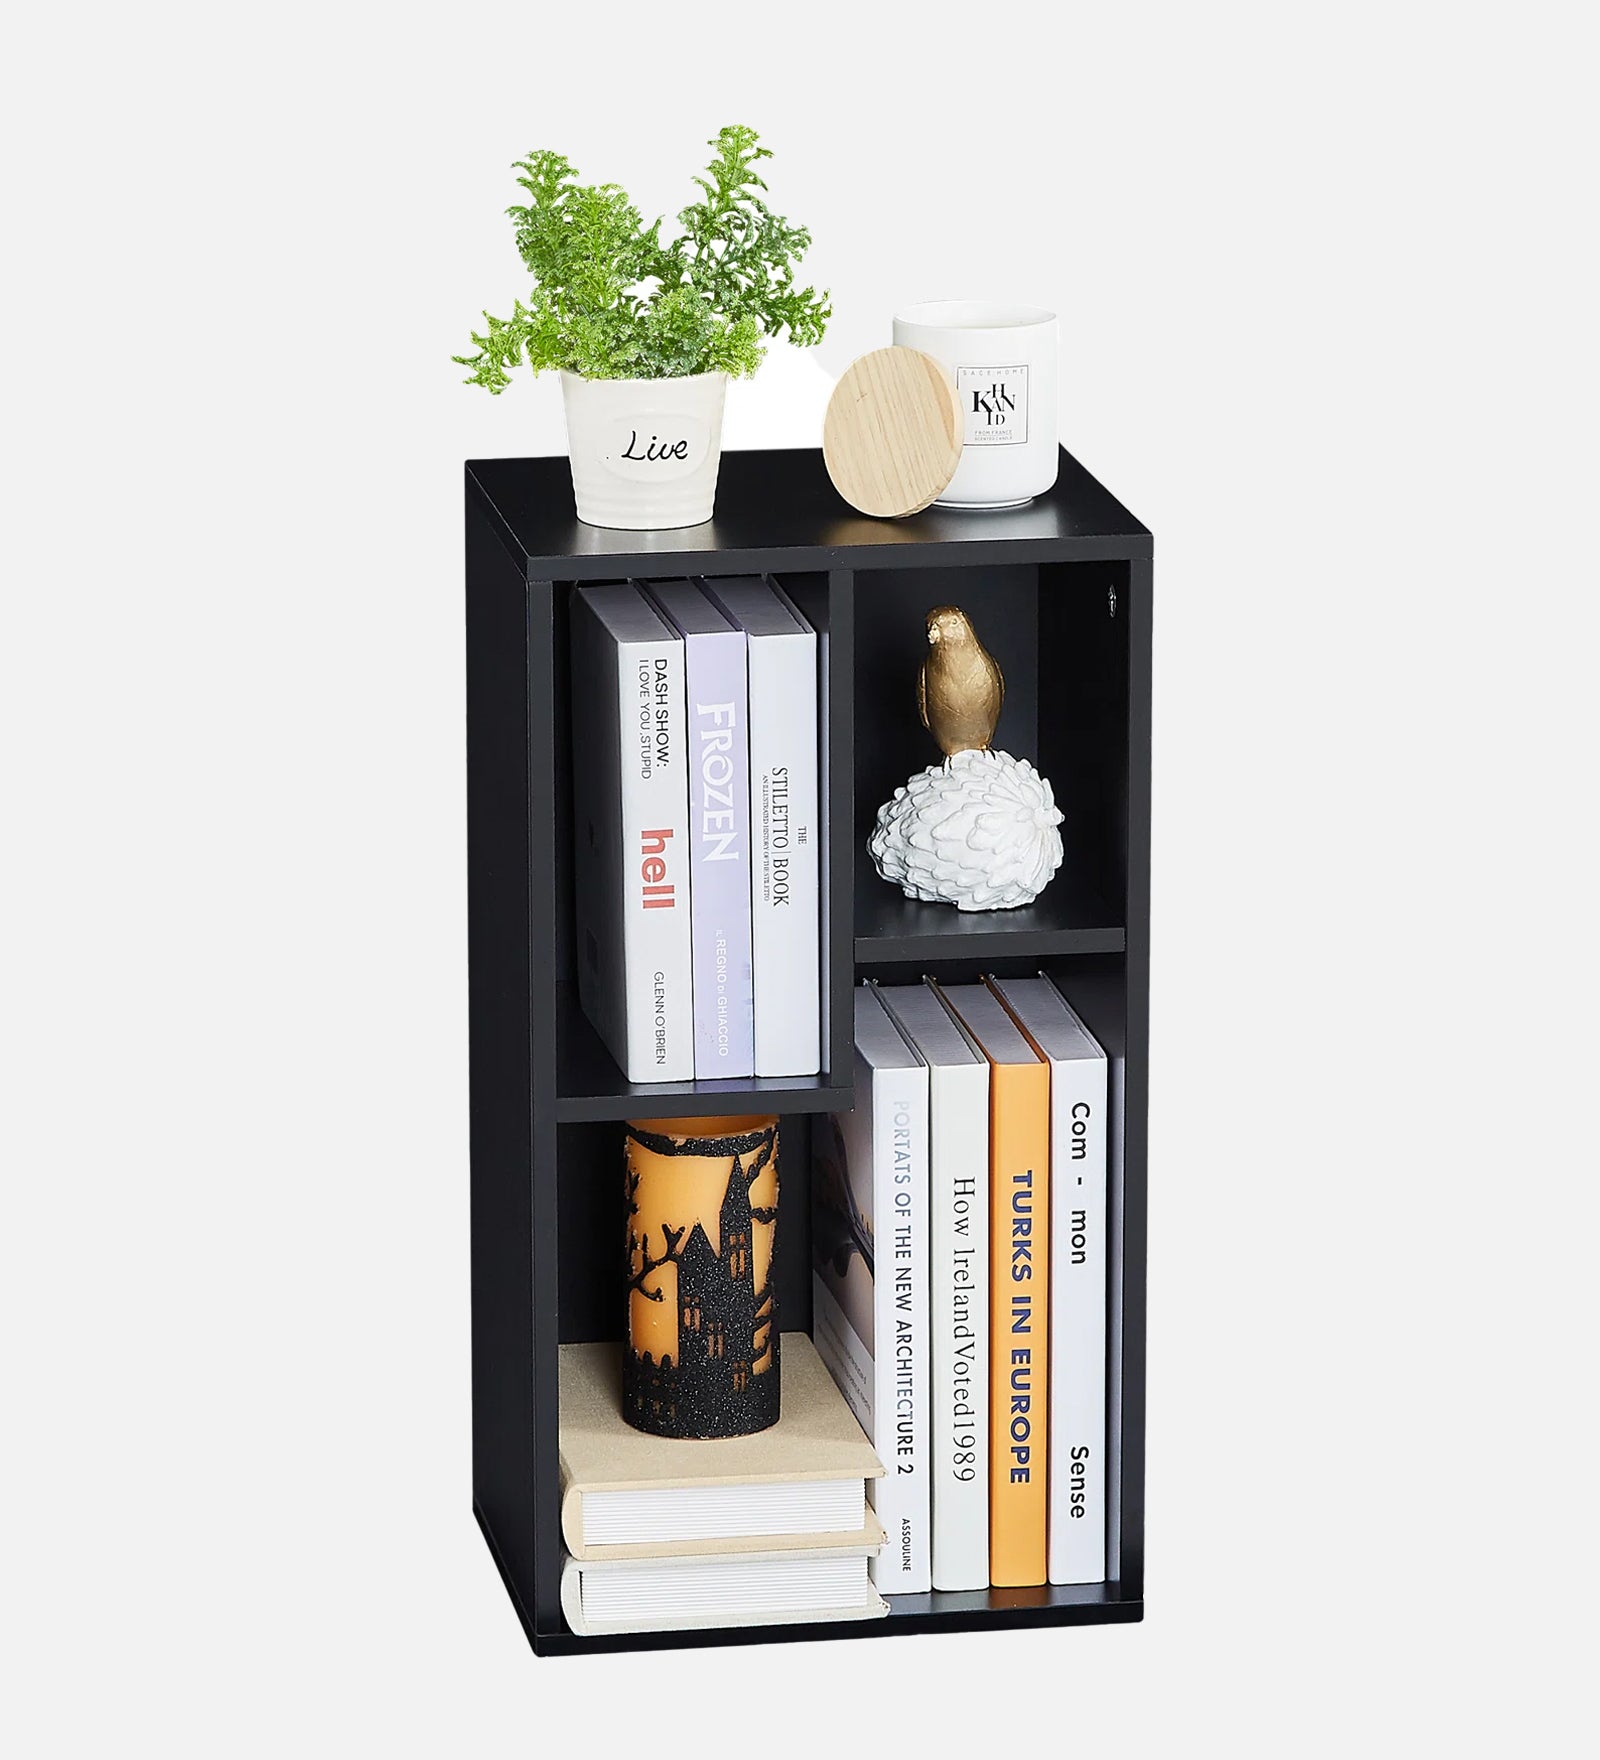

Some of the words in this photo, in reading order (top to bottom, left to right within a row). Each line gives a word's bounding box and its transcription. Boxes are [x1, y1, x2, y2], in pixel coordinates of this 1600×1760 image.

[619, 428, 690, 463] Live
[639, 665, 650, 697] LOVE
[655, 659, 668, 705] DASH
[656, 710, 669, 767] SHOW:
[696, 701, 740, 863] FROZEN
[772, 768, 789, 848] STILETTO
[798, 826, 807, 844] THE
[642, 830, 674, 908] hell
[773, 858, 789, 907] BOOK
[716, 939, 727, 983] REGNO
[654, 972, 664, 1013] GLENN
[718, 996, 728, 1057] GHIACCIO
[894, 1100, 911, 1185] PORTATS
[1072, 1102, 1090, 1159] Com
[895, 1193, 911, 1216] OF
[954, 1177, 975, 1236] How
[1012, 1171, 1032, 1281] TURKS
[895, 1225, 911, 1258] THE
[1071, 1210, 1086, 1264] mon
[895, 1268, 912, 1311] NEW
[1012, 1297, 1031, 1333] IN
[896, 1320, 913, 1455] ARCHITECTURE
[1011, 1349, 1030, 1482] EUROPE
[897, 1463, 915, 1476] 2
[1070, 1446, 1089, 1518] Sense
[902, 1519, 911, 1571] ASSOULINE
